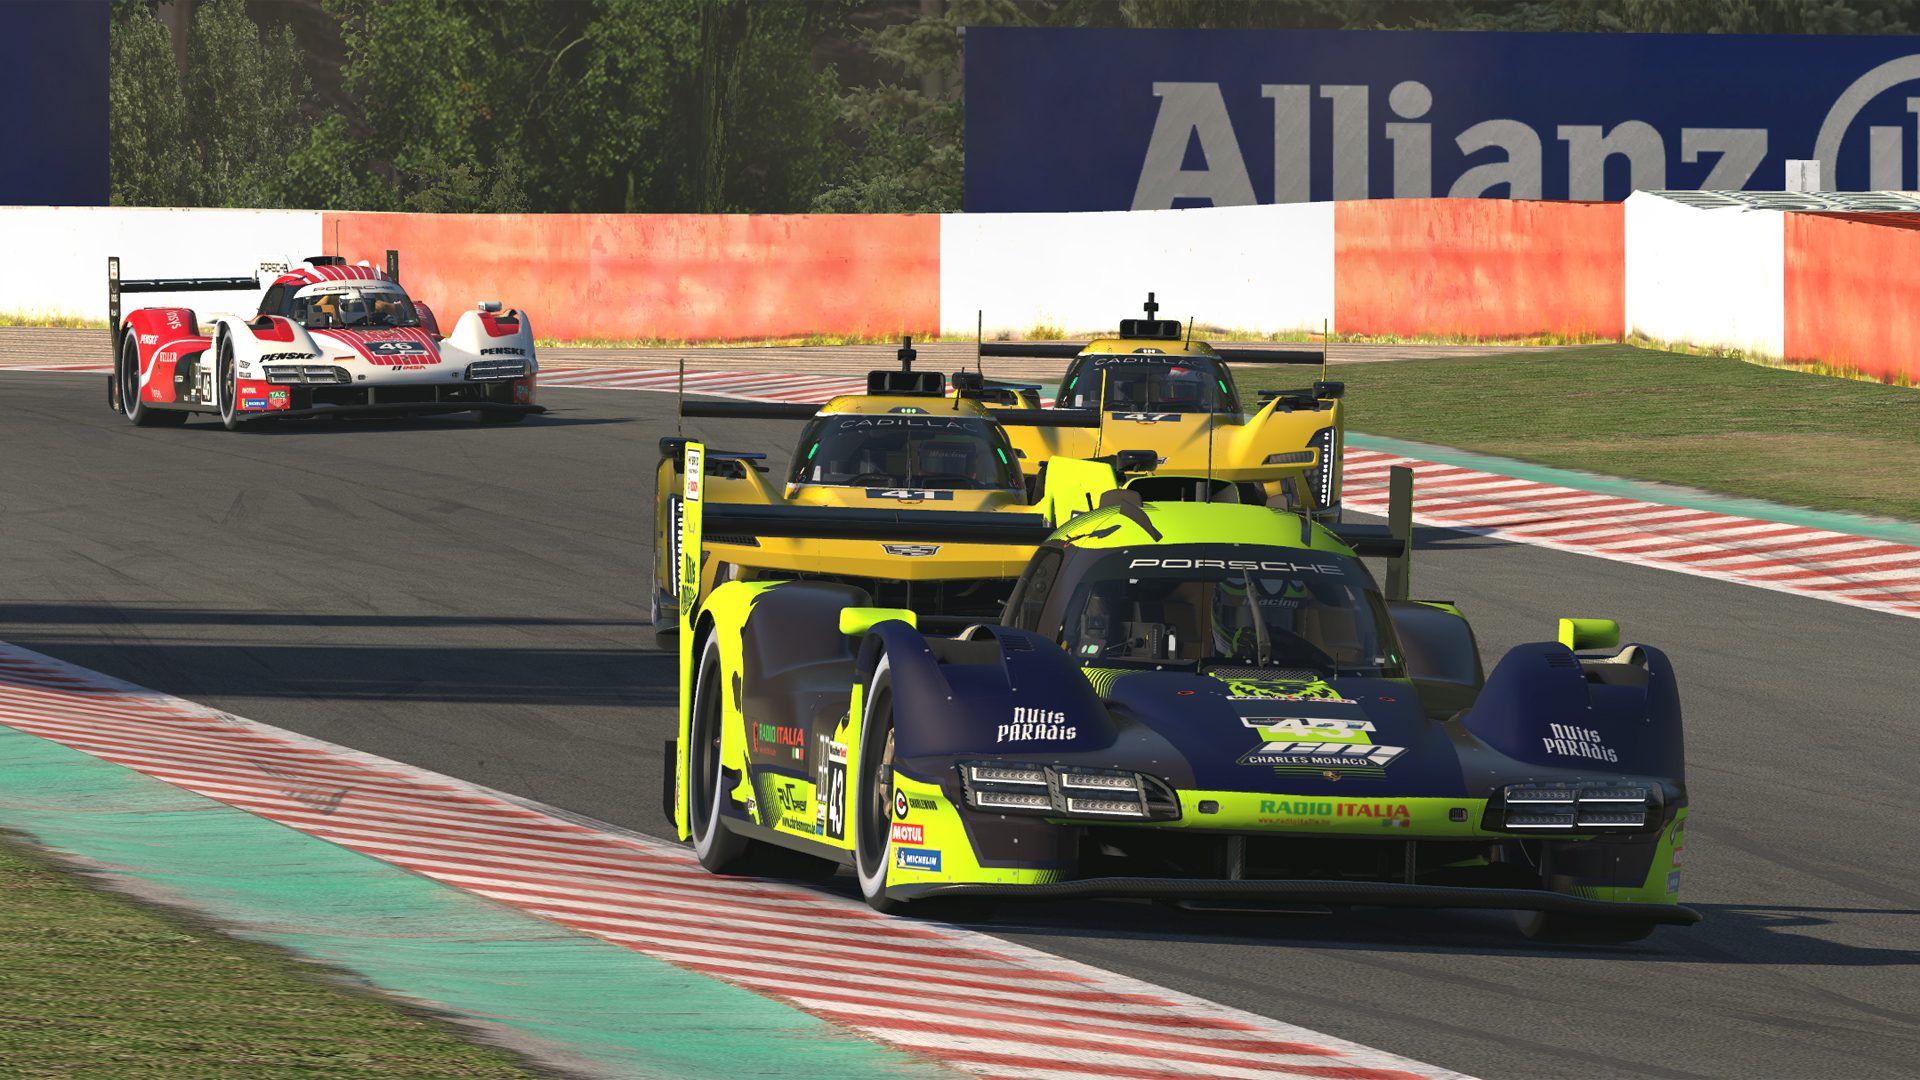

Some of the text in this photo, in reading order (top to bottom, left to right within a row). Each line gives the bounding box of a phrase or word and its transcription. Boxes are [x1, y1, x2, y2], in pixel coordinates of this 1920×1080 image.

[1131, 80, 1768, 211] Allianz
[379, 342, 413, 350] 46
[480, 347, 526, 356] PENSKE
[259, 352, 316, 363] PENSKE
[203, 374, 211, 402] 46
[1124, 413, 1166, 421] 47
[840, 419, 978, 432] CADILLAC
[881, 490, 935, 499] 41
[1129, 559, 1345, 576] PORSCHE
[759, 723, 805, 747] RADIO ITALIA
[1268, 718, 1355, 738] 43
[1249, 756, 1368, 766] CHARLES MONACO
[829, 767, 844, 835] 43
[1259, 799, 1410, 818] RADIO ITALIA
[892, 825, 922, 842] MOTUL
[906, 854, 937, 866] MICHELIN
